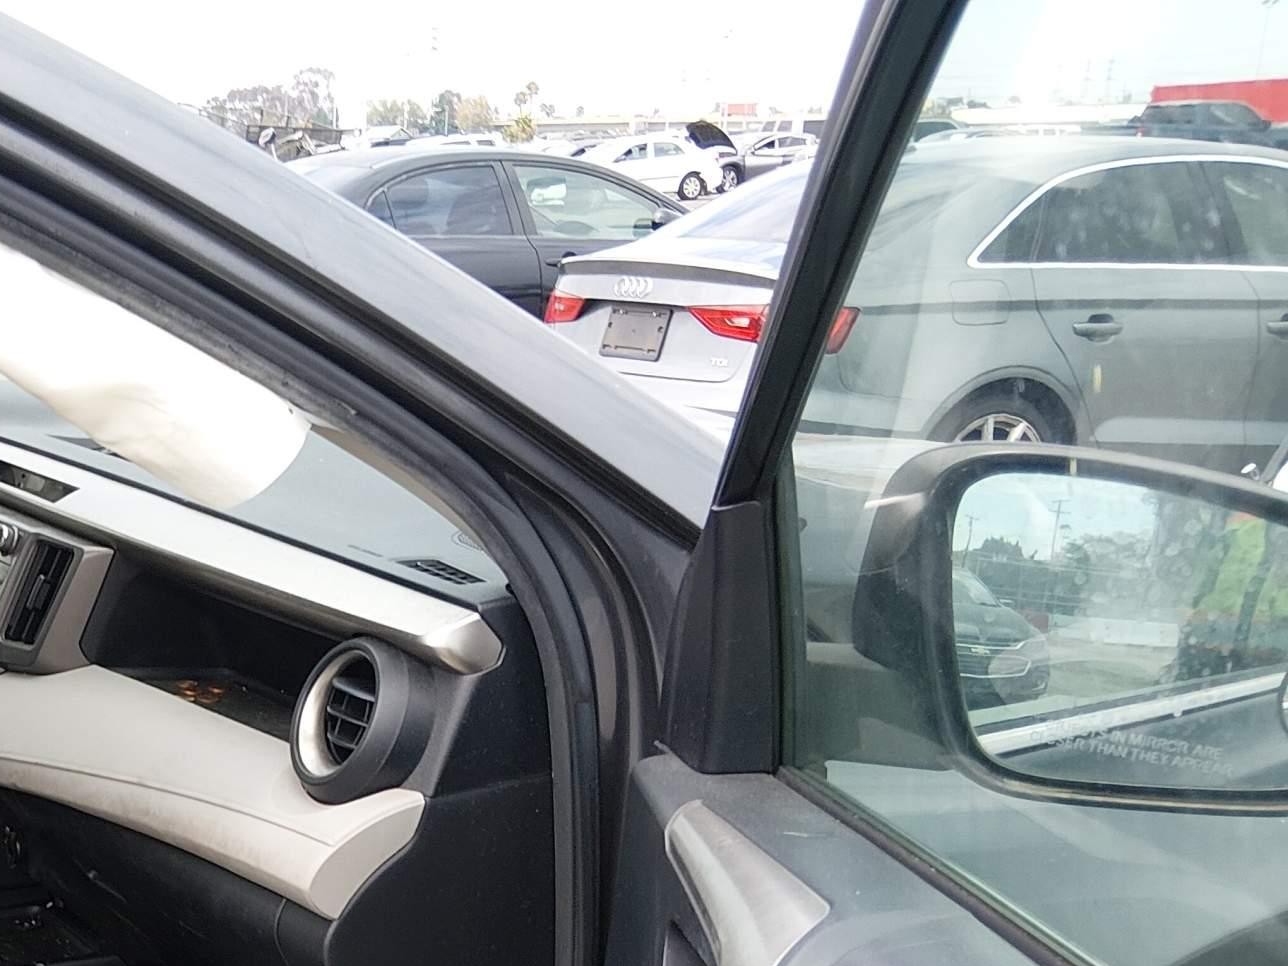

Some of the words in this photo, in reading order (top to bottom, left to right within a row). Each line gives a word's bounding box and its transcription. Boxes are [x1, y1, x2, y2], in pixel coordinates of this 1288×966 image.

[1088, 738, 1127, 759] THAN
[1130, 748, 1169, 767] THEY
[1171, 756, 1234, 777] APPEAR
[1110, 730, 1126, 744] IN
[1127, 733, 1189, 755] MIRROR
[1193, 744, 1224, 760] ARE
